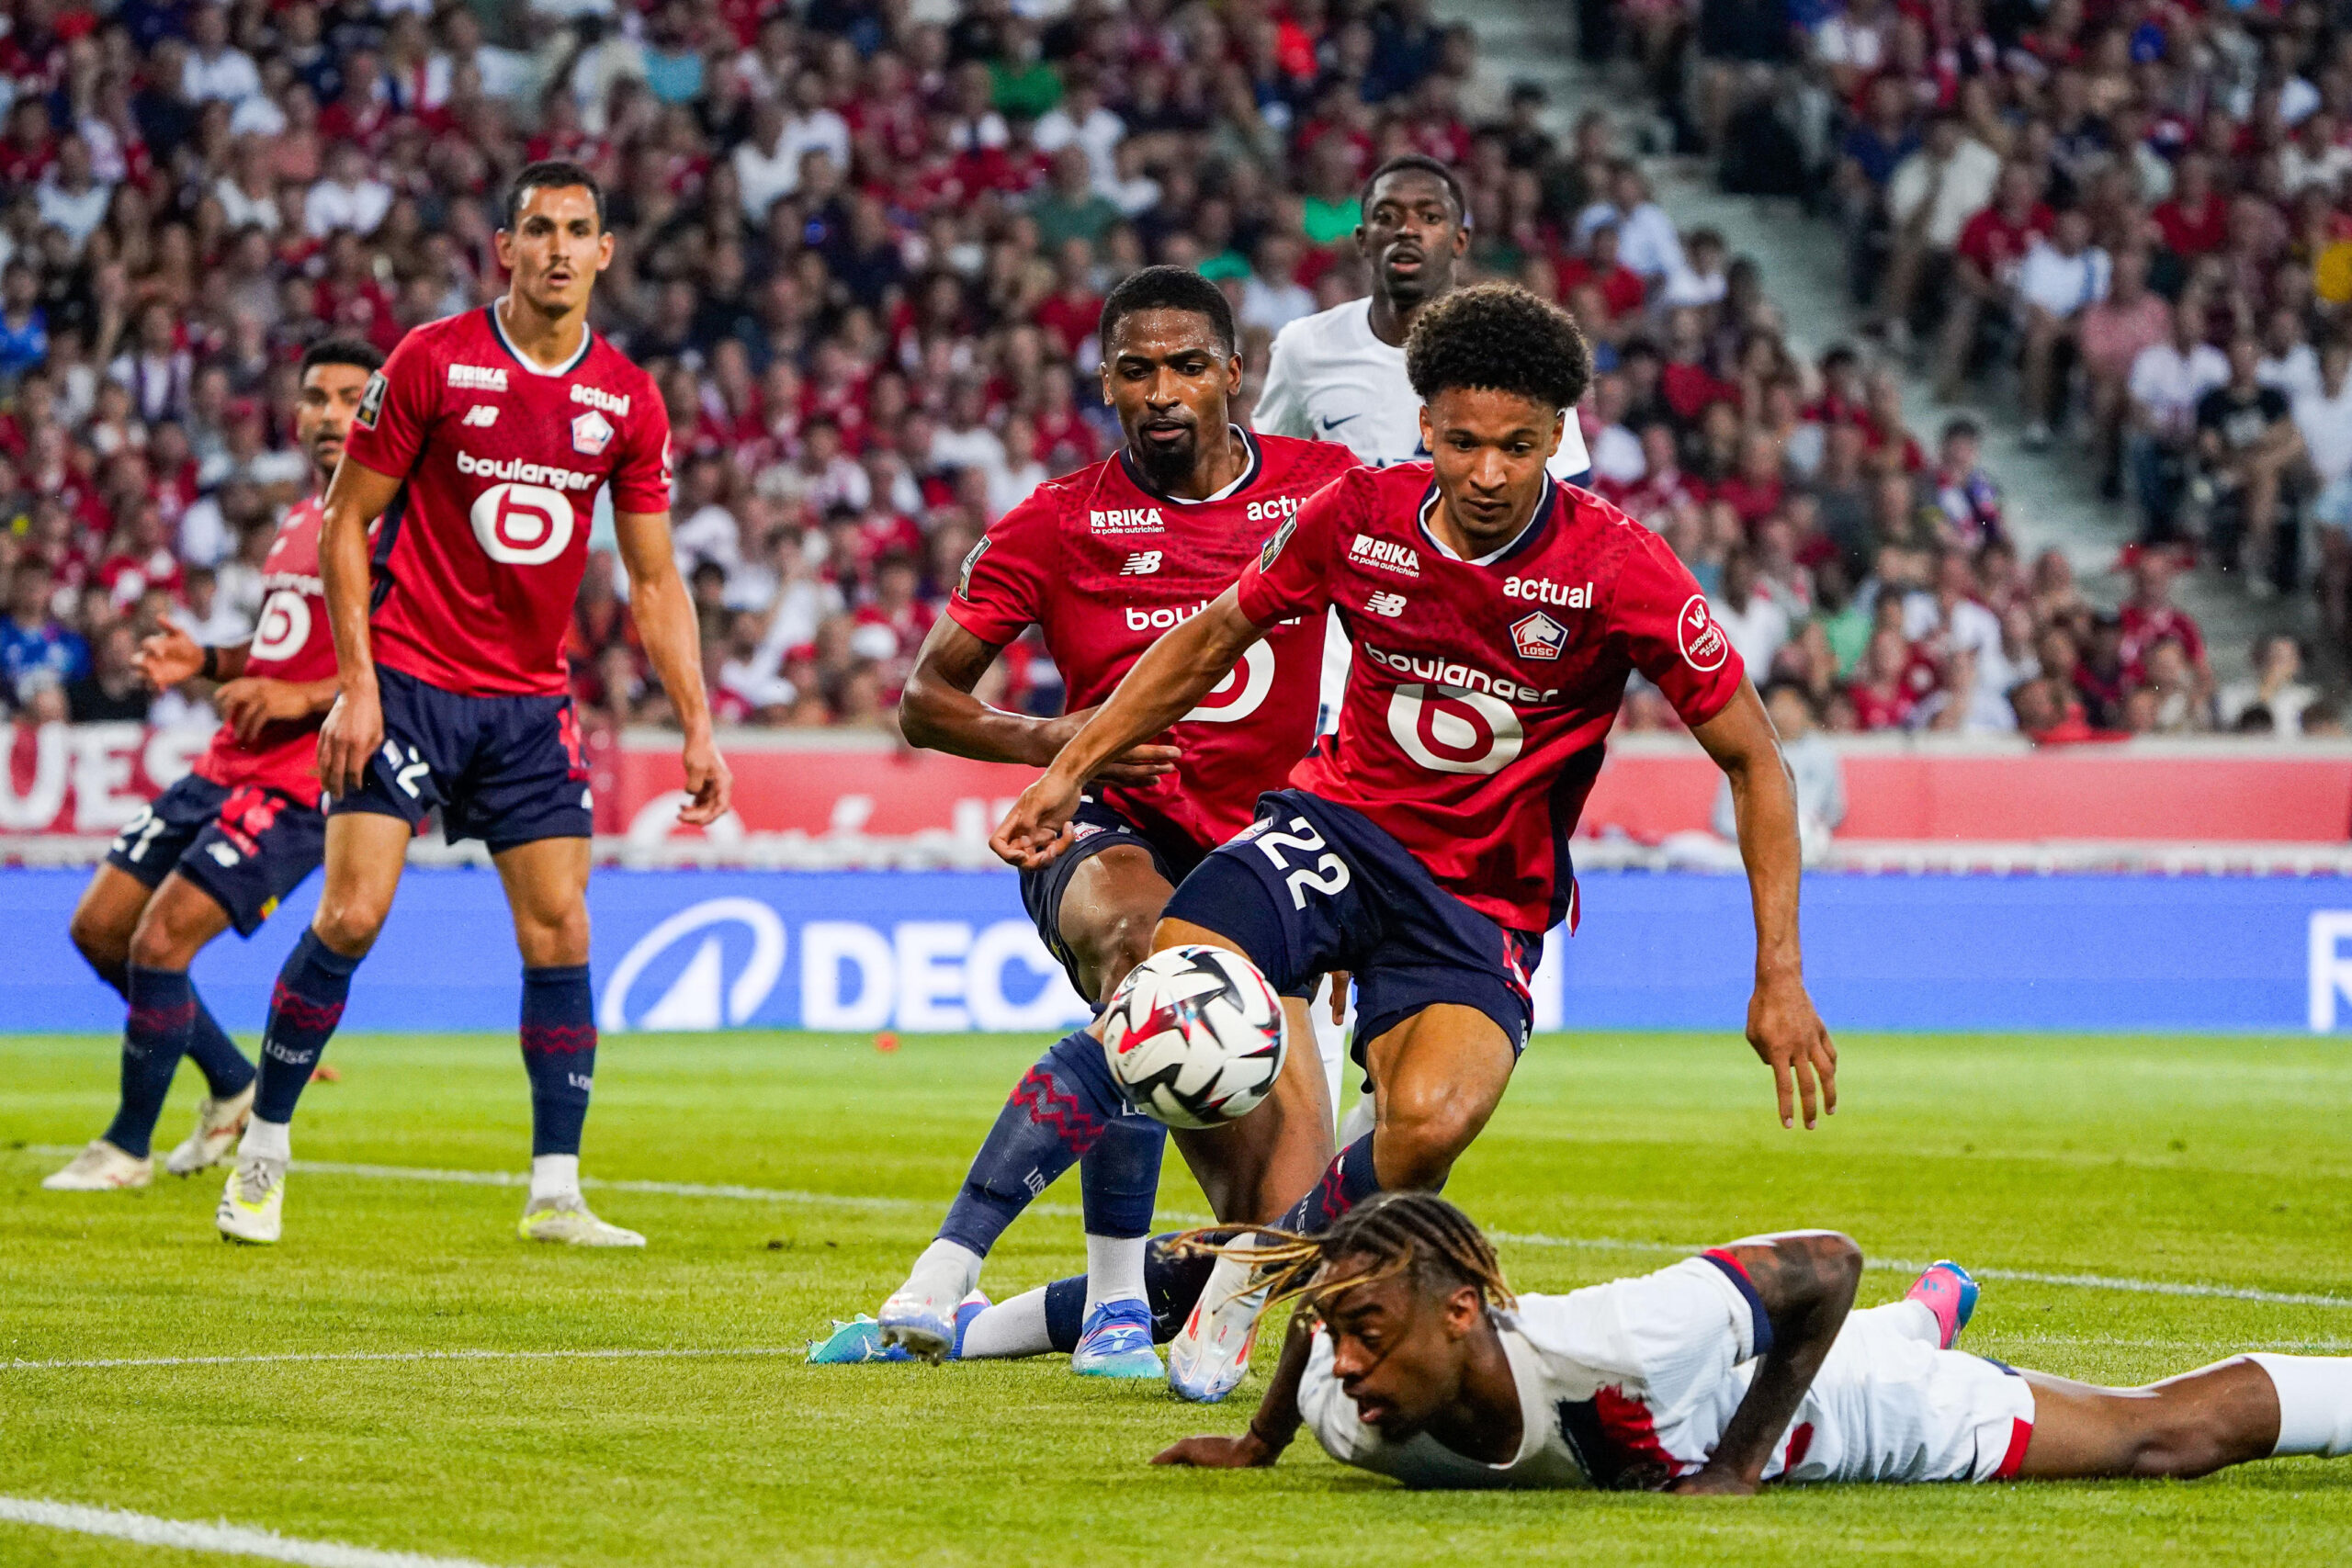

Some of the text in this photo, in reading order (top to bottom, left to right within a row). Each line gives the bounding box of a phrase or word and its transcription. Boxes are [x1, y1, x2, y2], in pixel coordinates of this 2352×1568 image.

[569, 383, 630, 417] actual
[456, 450, 597, 491] boulanger
[1091, 526, 1101, 535] Le
[1125, 525, 1165, 534] autrichien
[1106, 508, 1164, 527] RIKA
[1348, 551, 1360, 561] Le
[1379, 561, 1419, 579] autrichien
[1370, 539, 1420, 570] RIKA
[1502, 575, 1594, 609] actual
[1523, 646, 1554, 657] LOSC
[1364, 641, 1559, 703] boulanger
[1255, 816, 1351, 911] 22
[799, 919, 1091, 1032] DEC
[266, 1038, 313, 1066] LOSC
